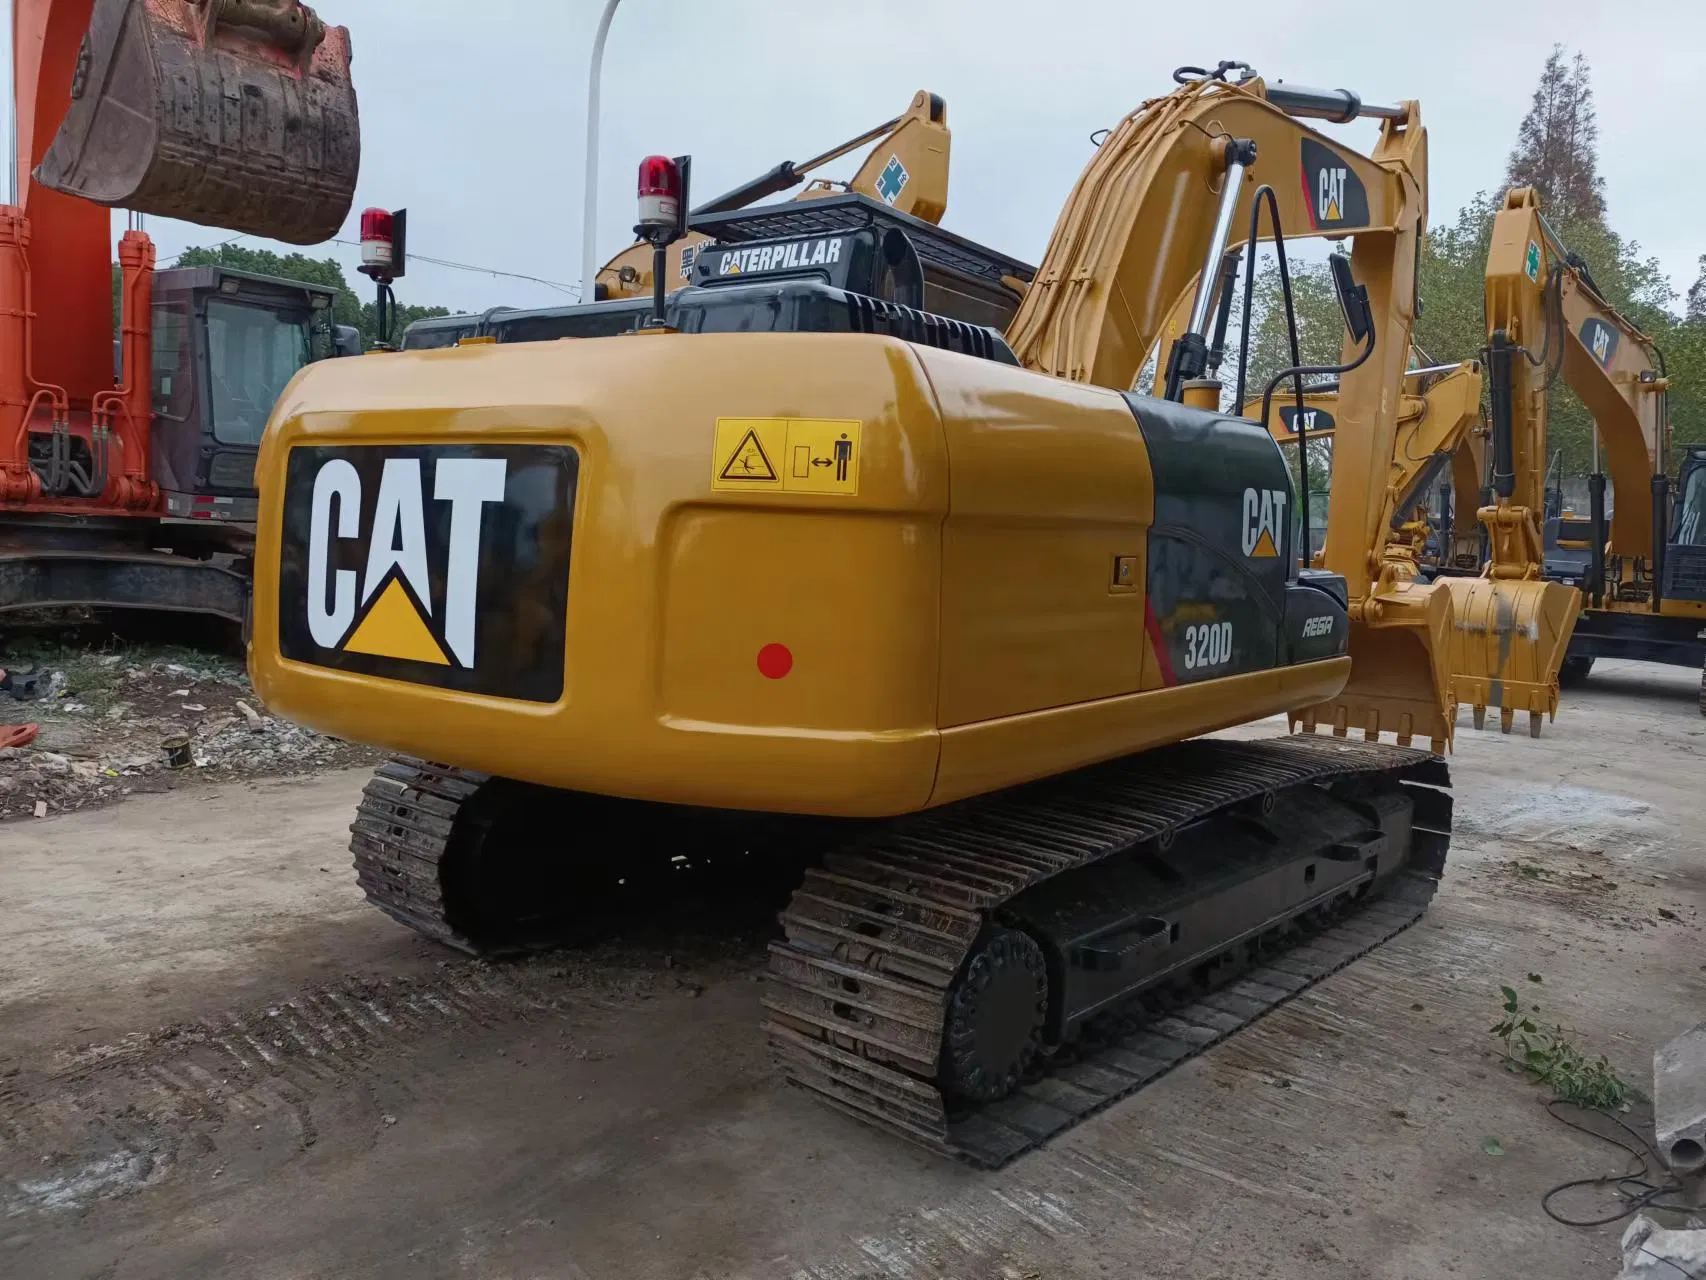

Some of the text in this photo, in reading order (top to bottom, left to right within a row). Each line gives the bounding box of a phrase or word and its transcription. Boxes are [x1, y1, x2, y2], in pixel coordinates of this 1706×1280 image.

[1318, 168, 1347, 220] CAT
[719, 238, 842, 275] CATERPILLAR
[1593, 324, 1609, 362] CAT
[1242, 488, 1286, 557] CAT
[308, 457, 509, 670] CAT
[1185, 622, 1233, 669] 320D
